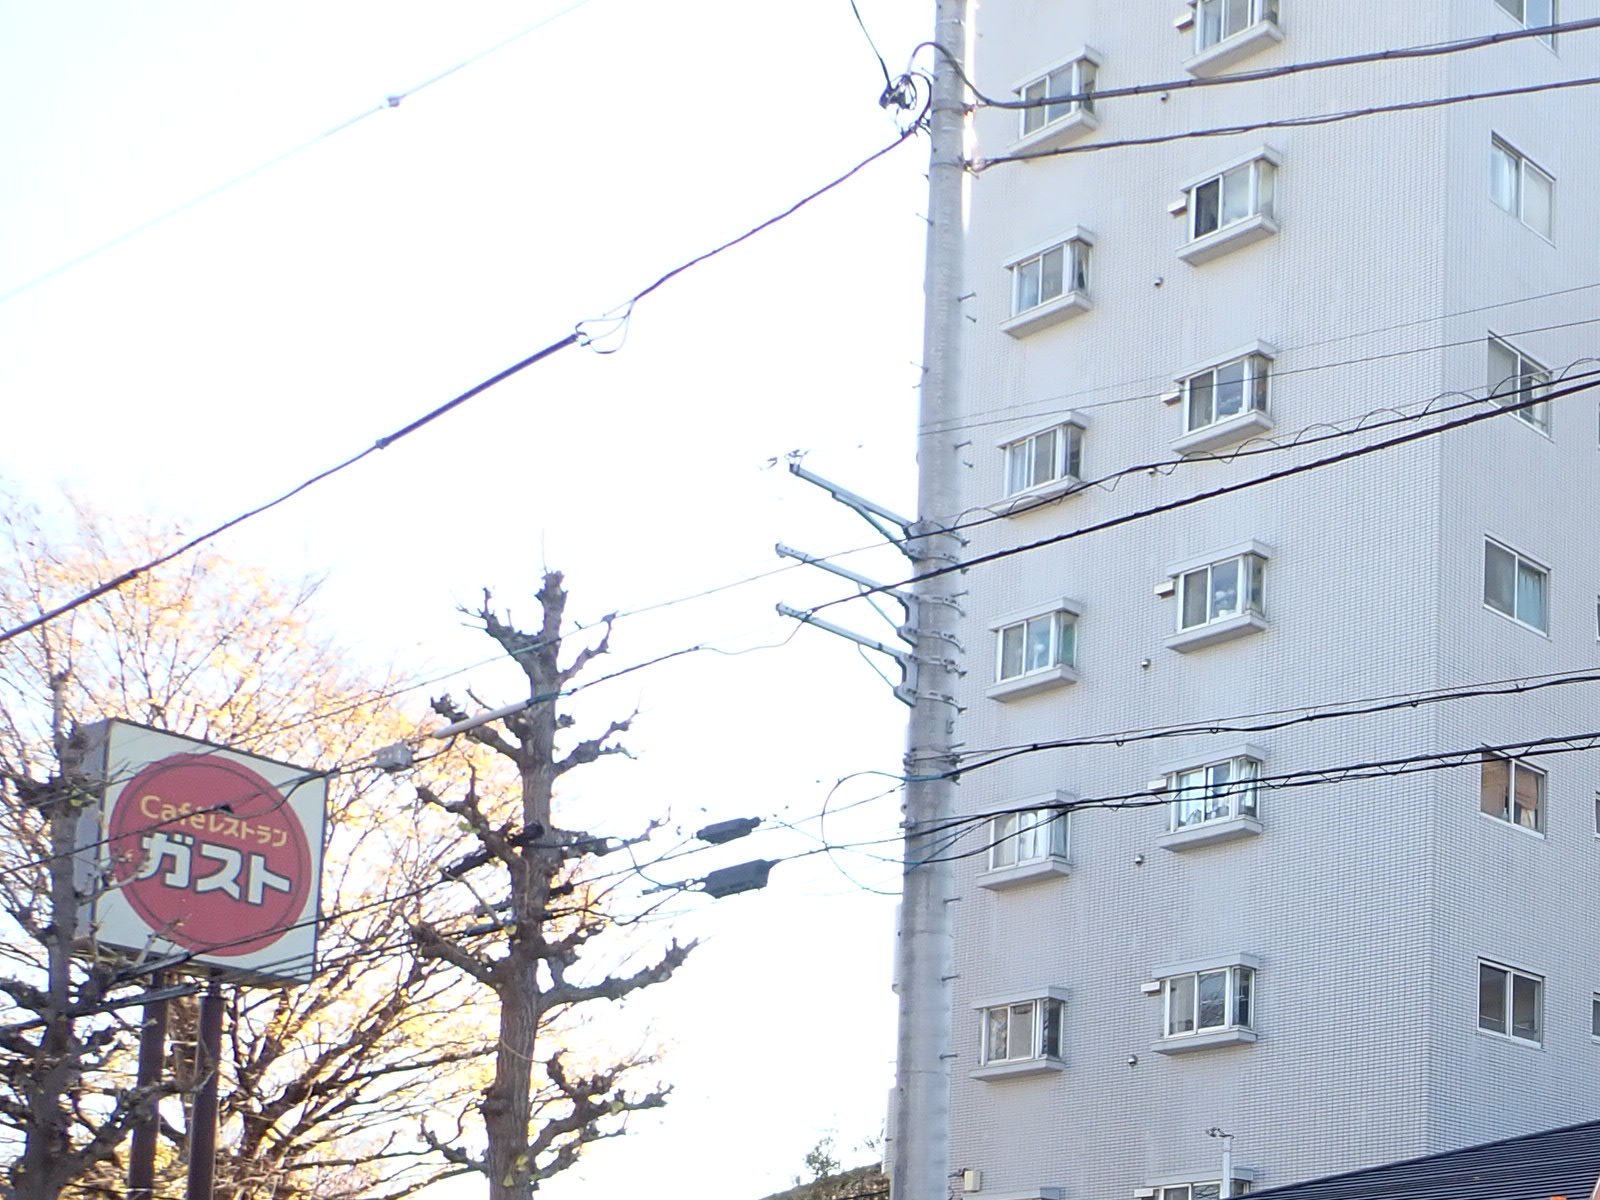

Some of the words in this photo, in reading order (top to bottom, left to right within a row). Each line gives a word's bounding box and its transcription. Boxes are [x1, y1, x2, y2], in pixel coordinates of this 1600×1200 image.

[140, 795, 288, 847] Caféレストラン
[136, 832, 291, 905] ガスト
